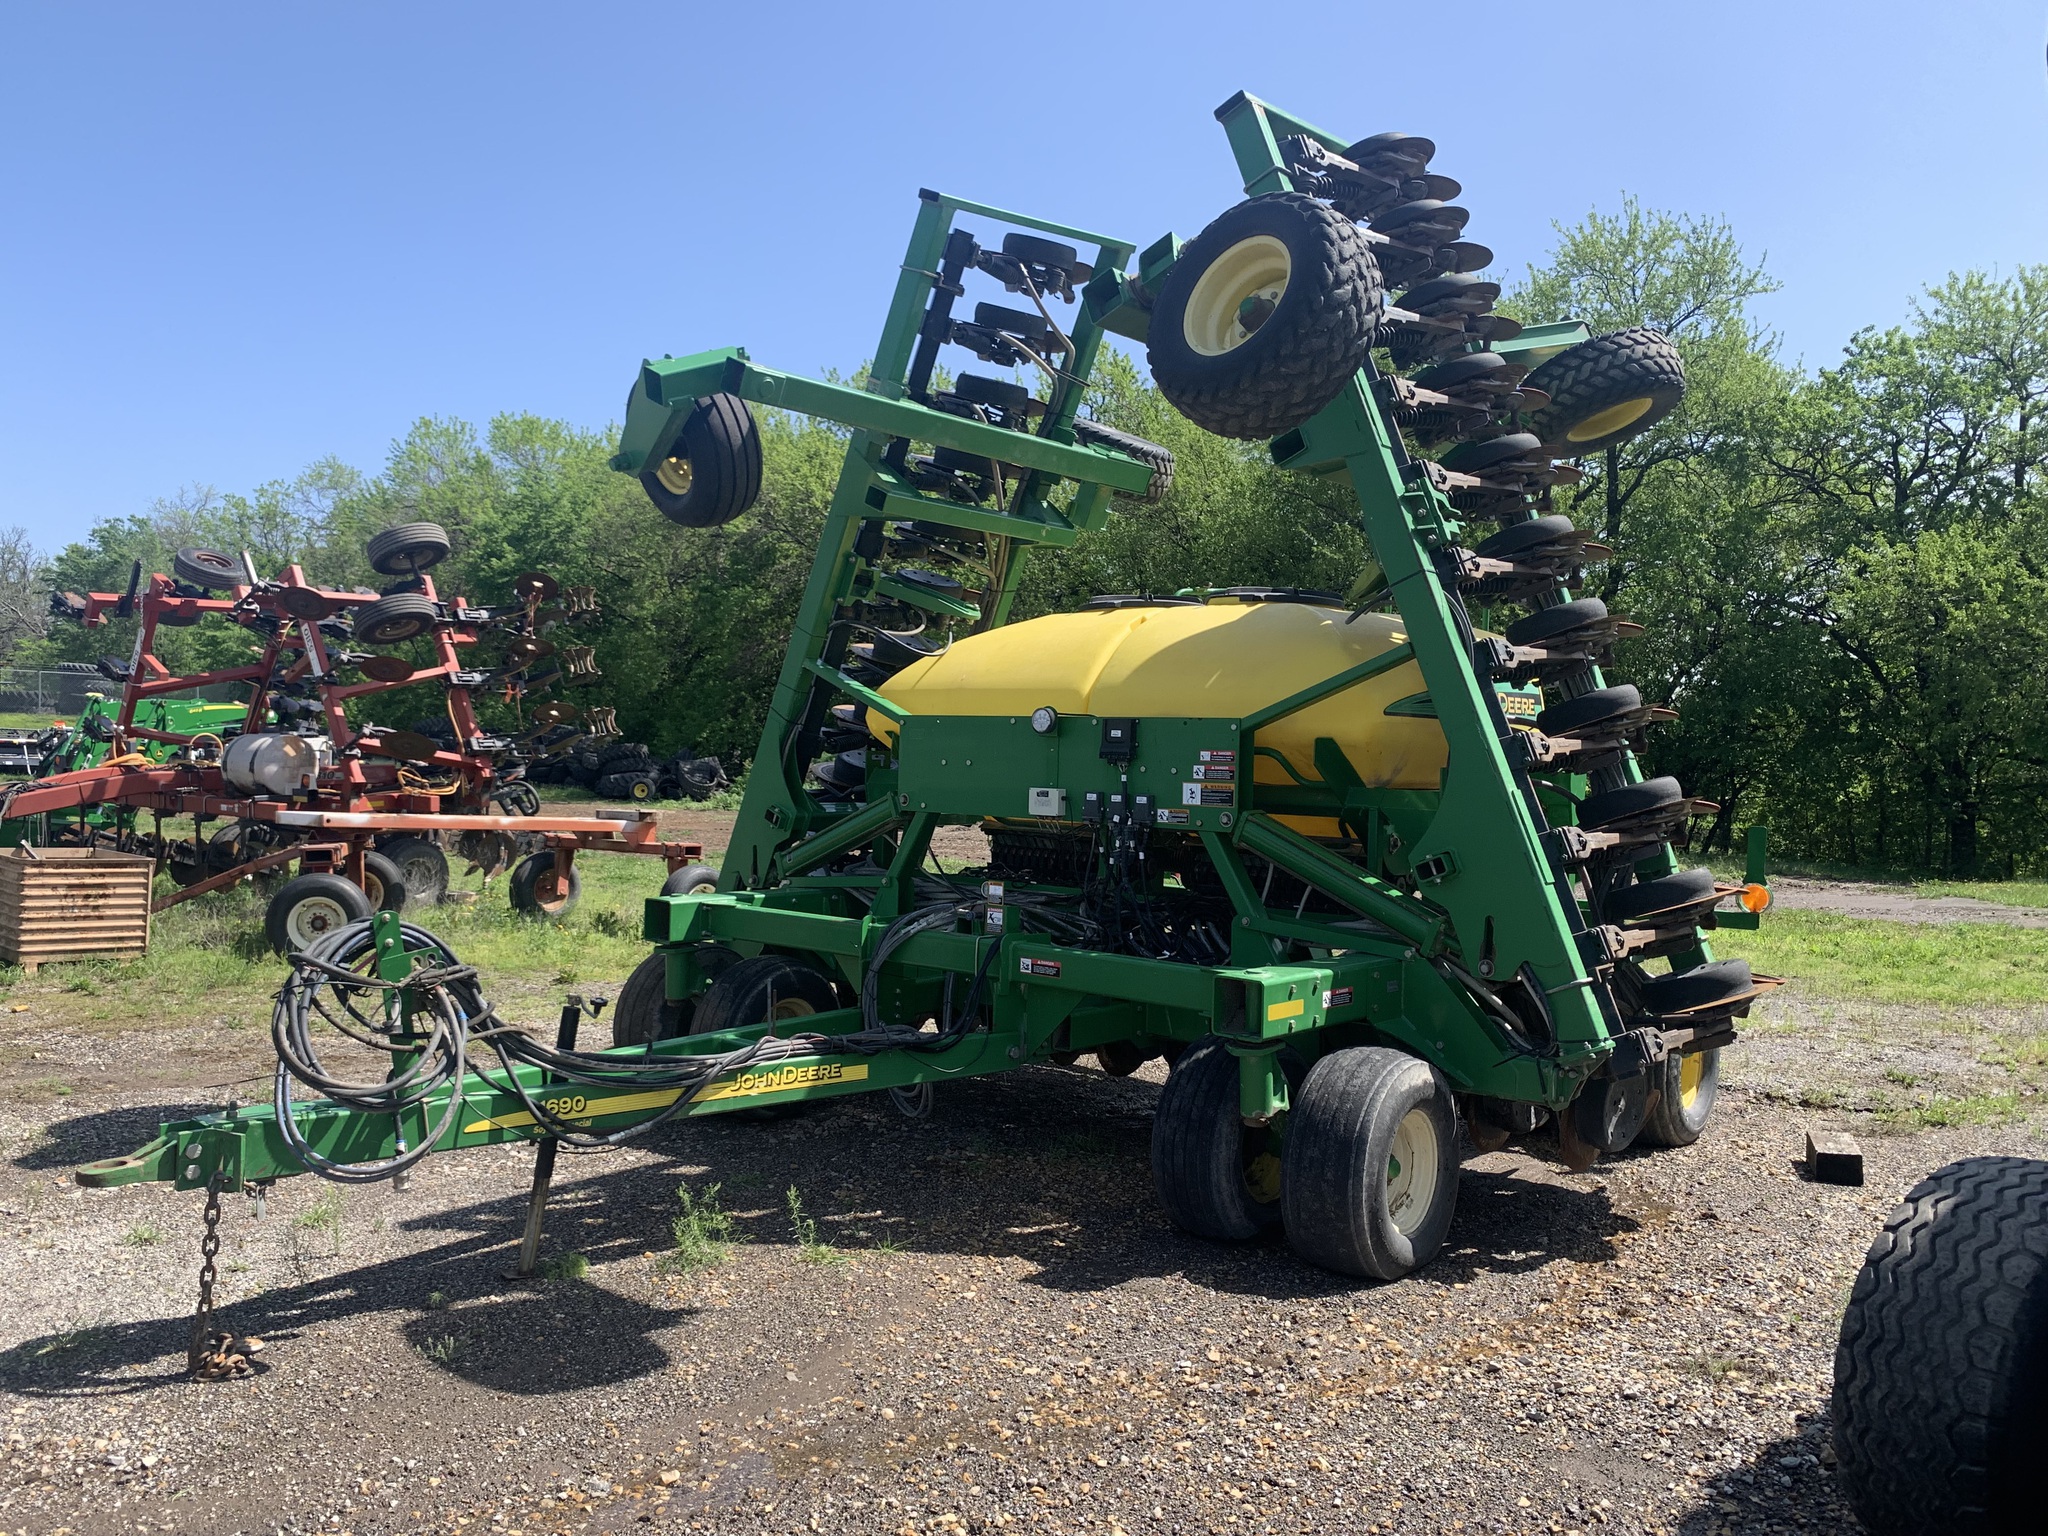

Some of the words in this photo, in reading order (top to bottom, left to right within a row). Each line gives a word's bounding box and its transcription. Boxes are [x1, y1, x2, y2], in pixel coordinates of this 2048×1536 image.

[1497, 692, 1536, 715] DEERE
[730, 1071, 781, 1091] JOHN
[783, 1063, 843, 1085] DEERE
